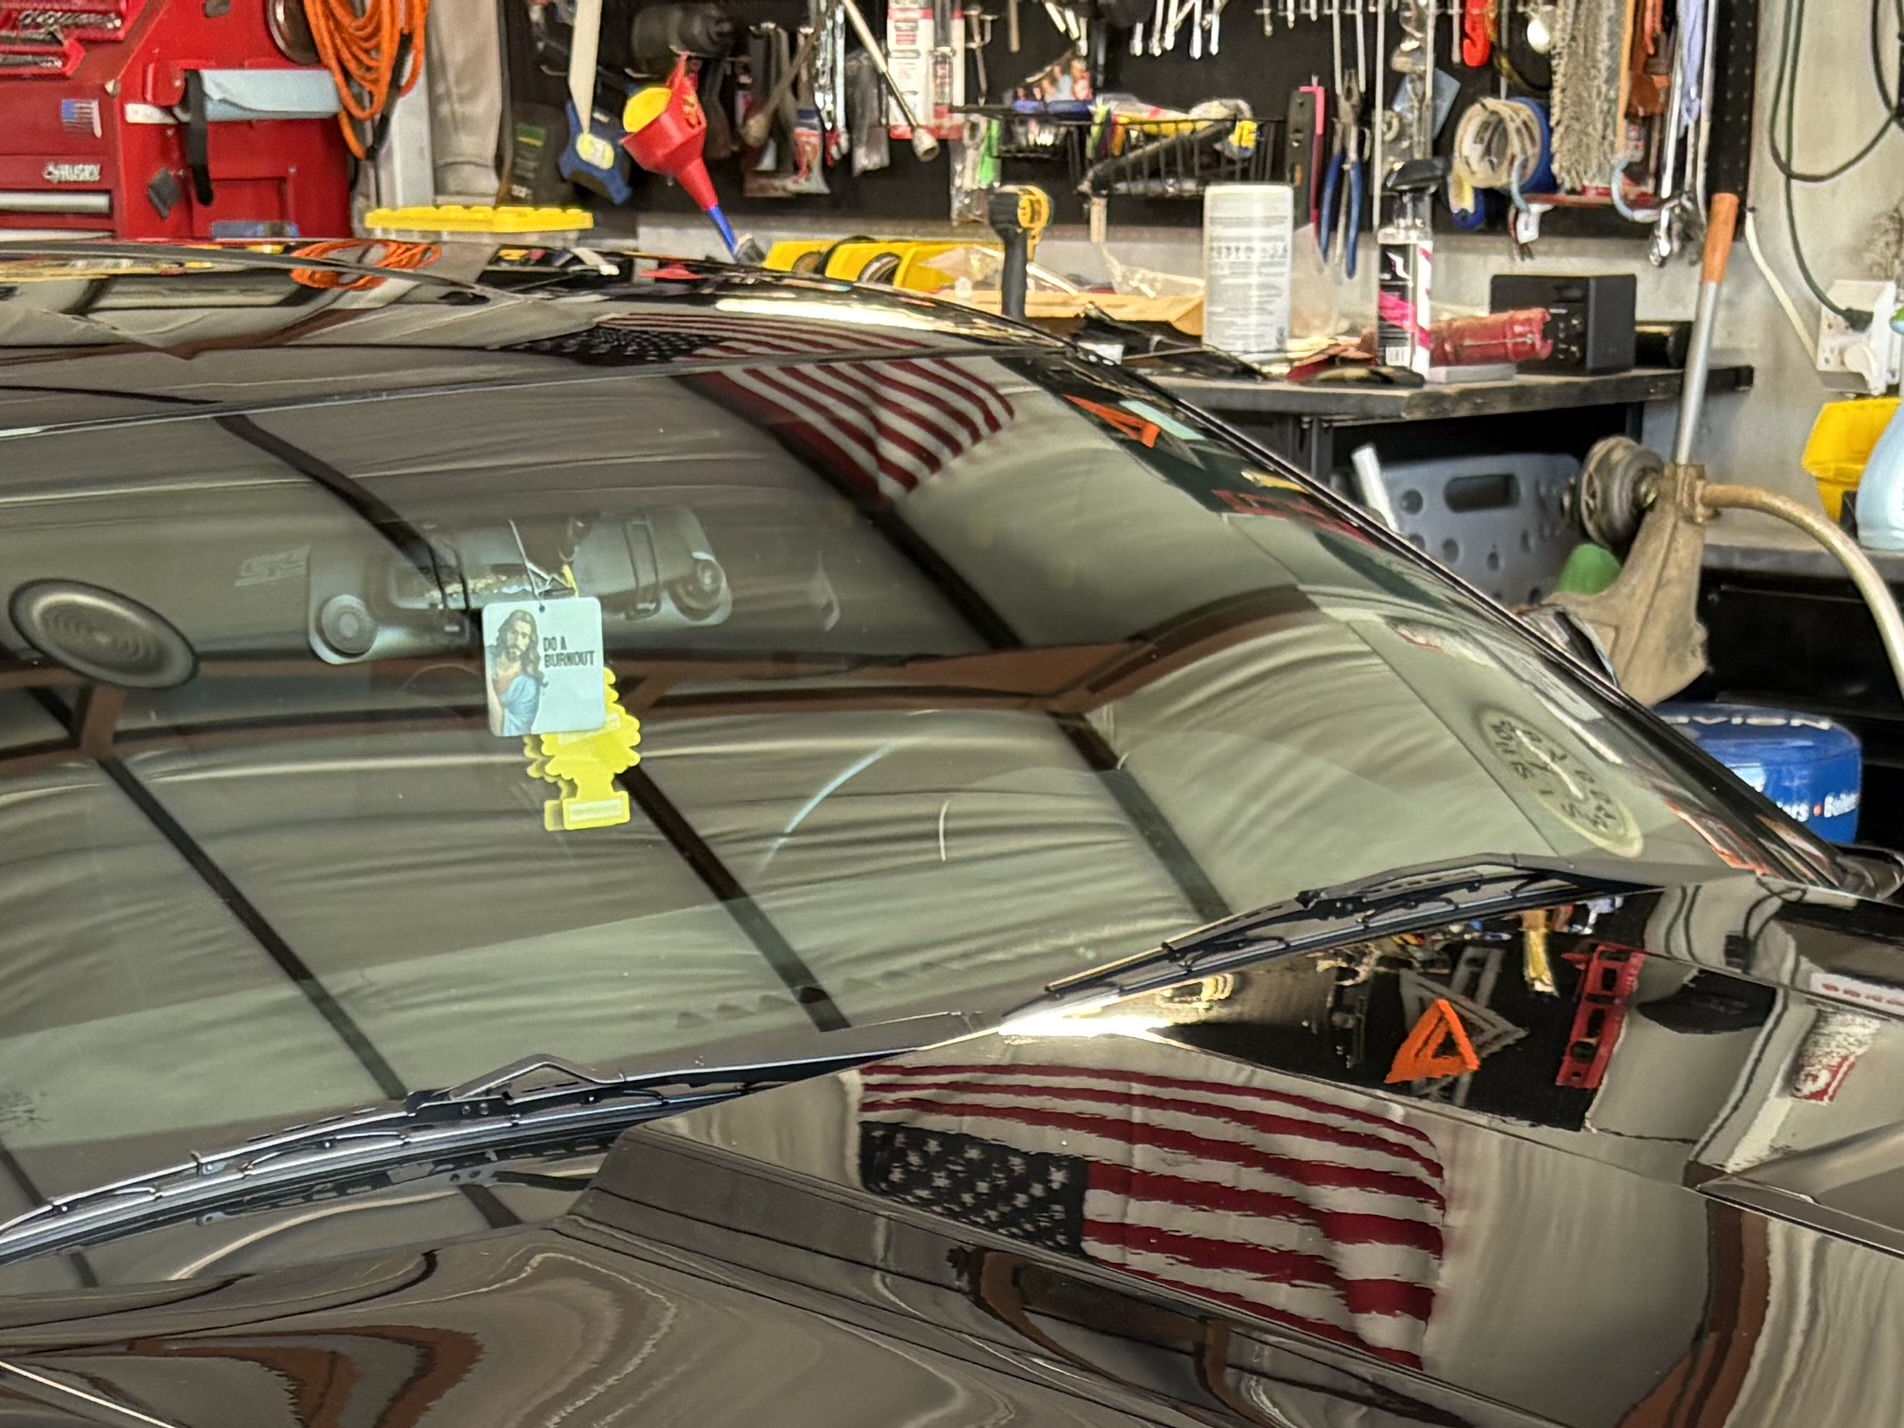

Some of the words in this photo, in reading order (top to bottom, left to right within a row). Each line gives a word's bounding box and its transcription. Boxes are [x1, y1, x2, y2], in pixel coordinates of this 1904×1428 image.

[543, 636, 557, 652] DO
[560, 636, 567, 651] A
[543, 650, 595, 668] BURNOUT
